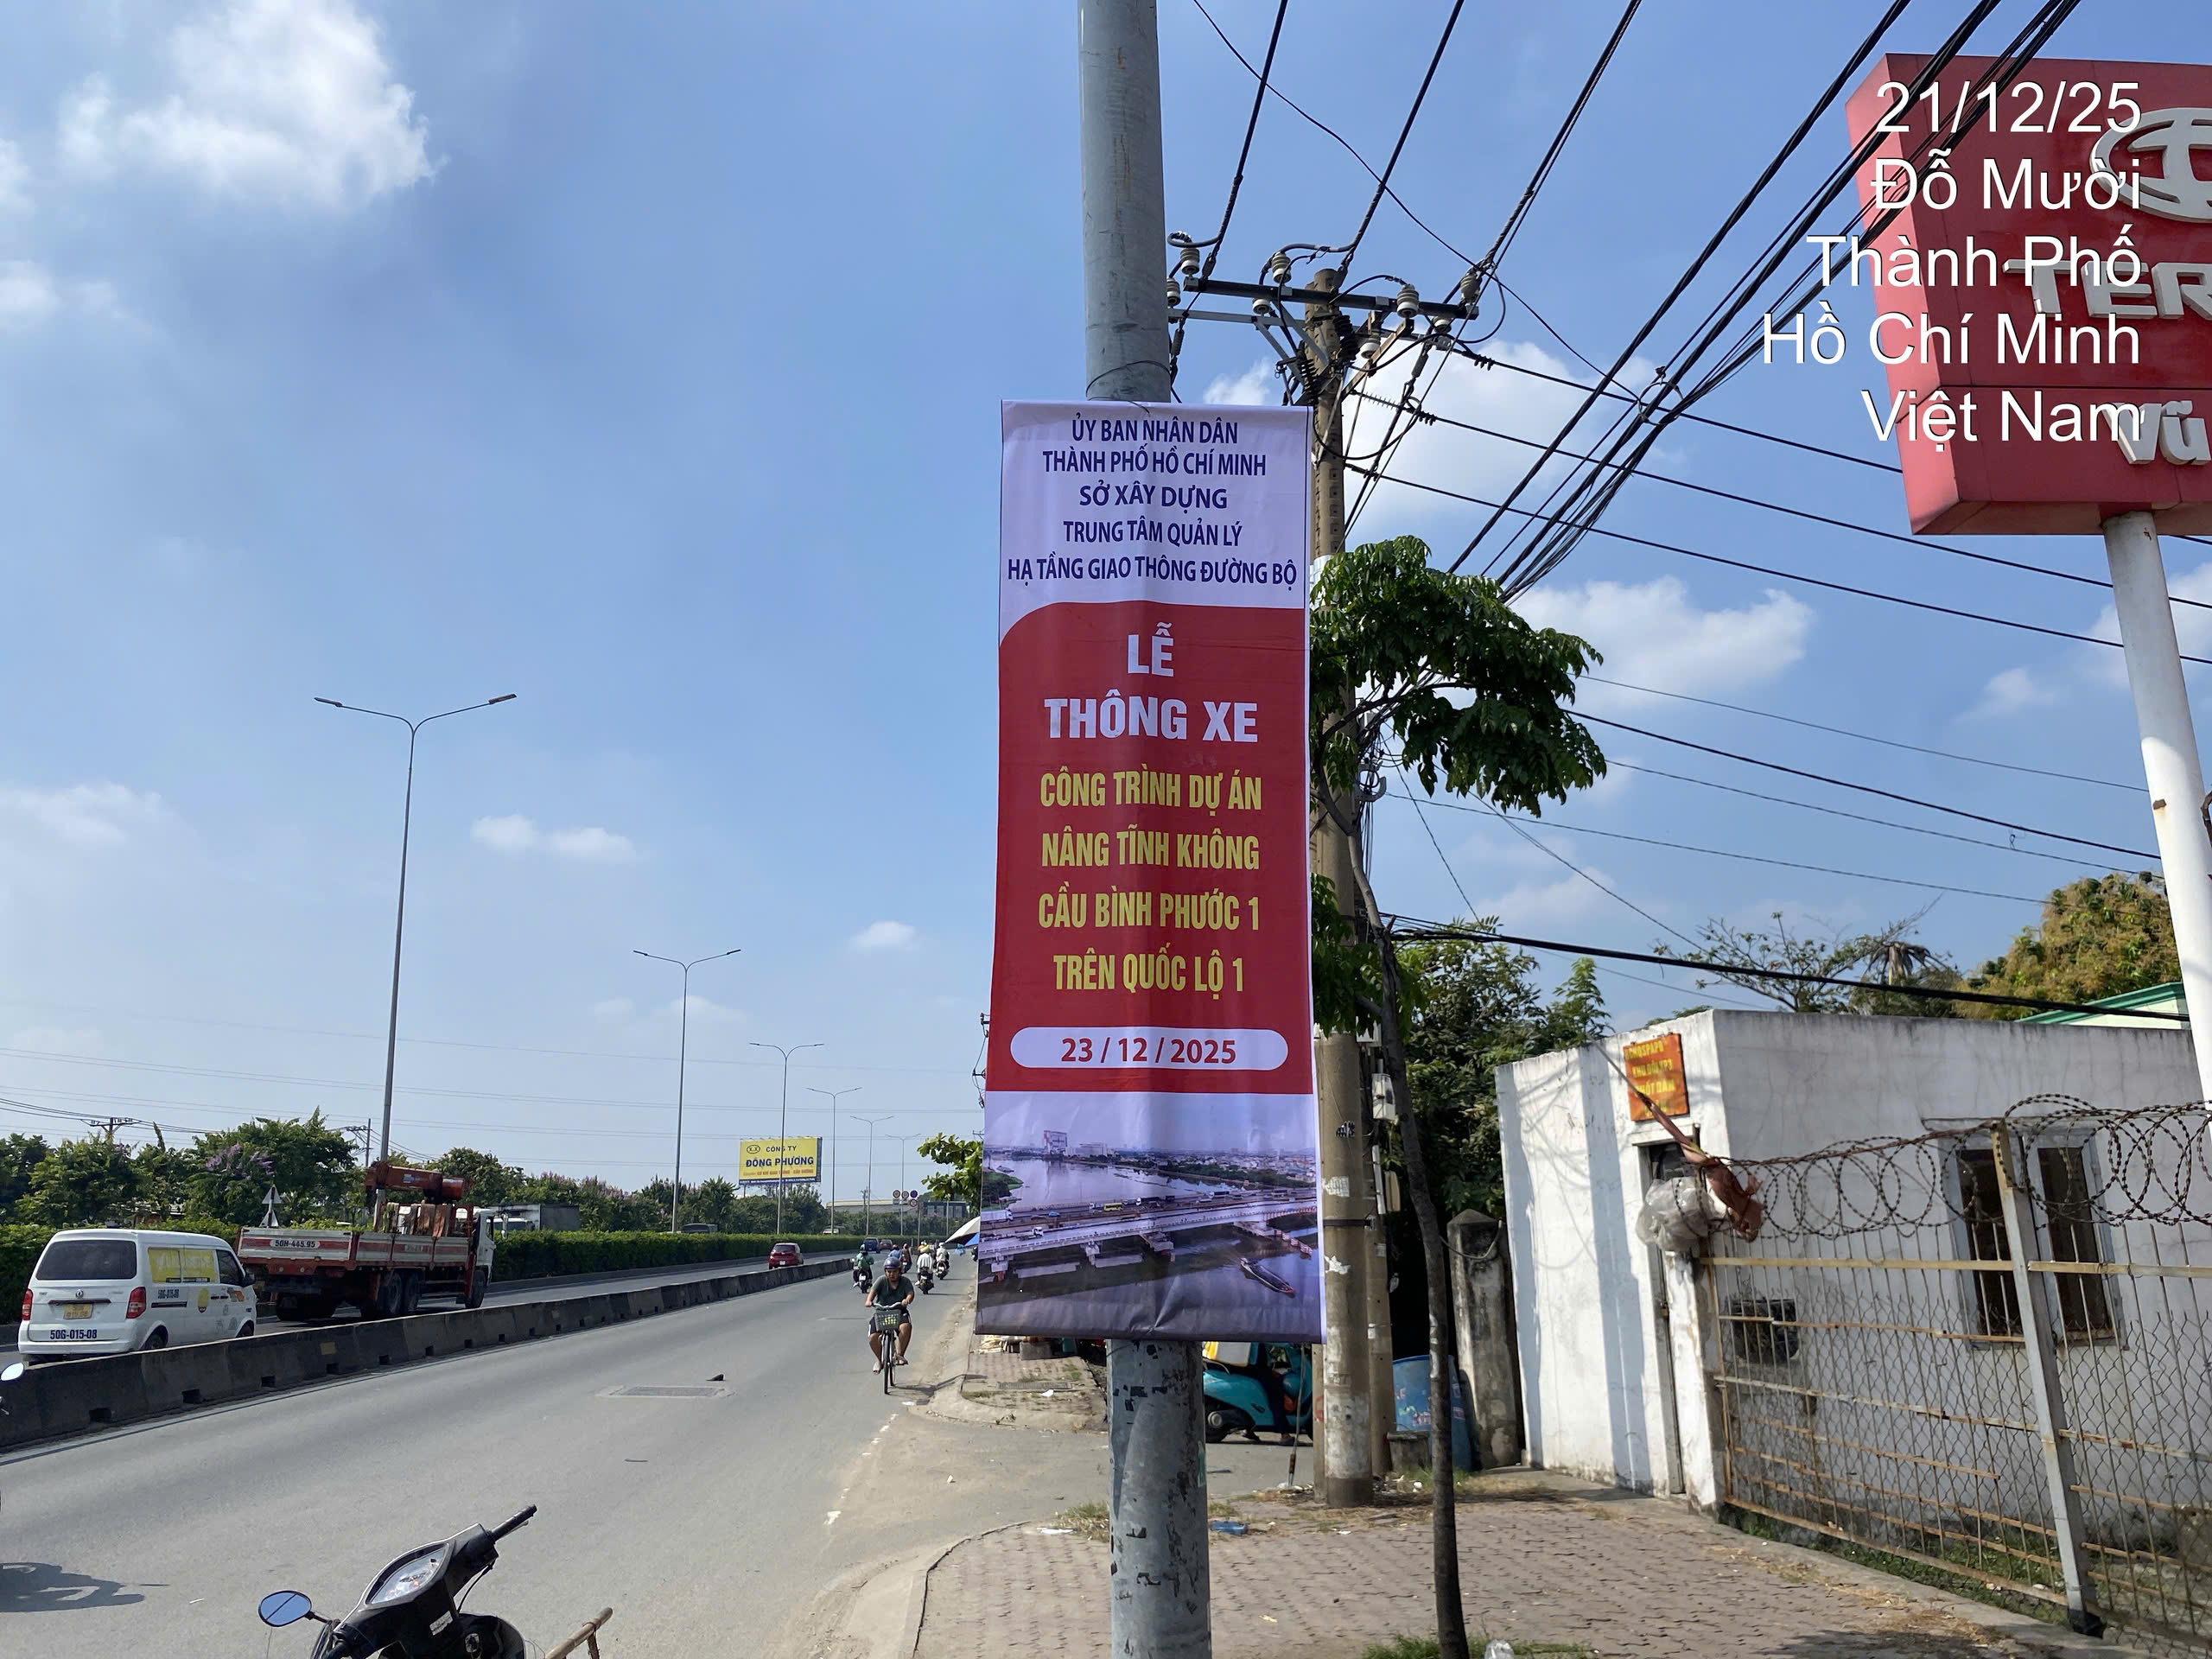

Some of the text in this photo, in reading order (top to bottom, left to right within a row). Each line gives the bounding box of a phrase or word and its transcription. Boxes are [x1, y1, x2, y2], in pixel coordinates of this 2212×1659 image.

[1071, 413, 1238, 444] ỦY BAN NHÂN DÂN
[1042, 443, 1267, 476] THÀNH PHỐ HỒ CHÍ MINH
[1079, 479, 1228, 514] SỞ XÂY DỰNG
[1063, 515, 1243, 547] TRUNG TÂM QUẢN LÝ
[1007, 550, 1297, 591] HẠ TẦNG GIAO THÔNG ĐƯỜNG BỘ
[1127, 621, 1175, 677] LỄ
[1044, 689, 1259, 743] THÔNG XE
[1040, 763, 1262, 817] CÔNG TRÌNH DỰ ÁN
[1041, 823, 1259, 870] NÂNG TĨNH KHÔNG
[1039, 881, 1259, 931] CẦU BÌNH PHƯỚC 1
[1052, 943, 1243, 1000] TRÊN QUỐC LỘ 1
[1061, 1038, 1093, 1063] 23
[1118, 1037, 1147, 1062] 12
[1170, 1039, 1236, 1065] 2025
